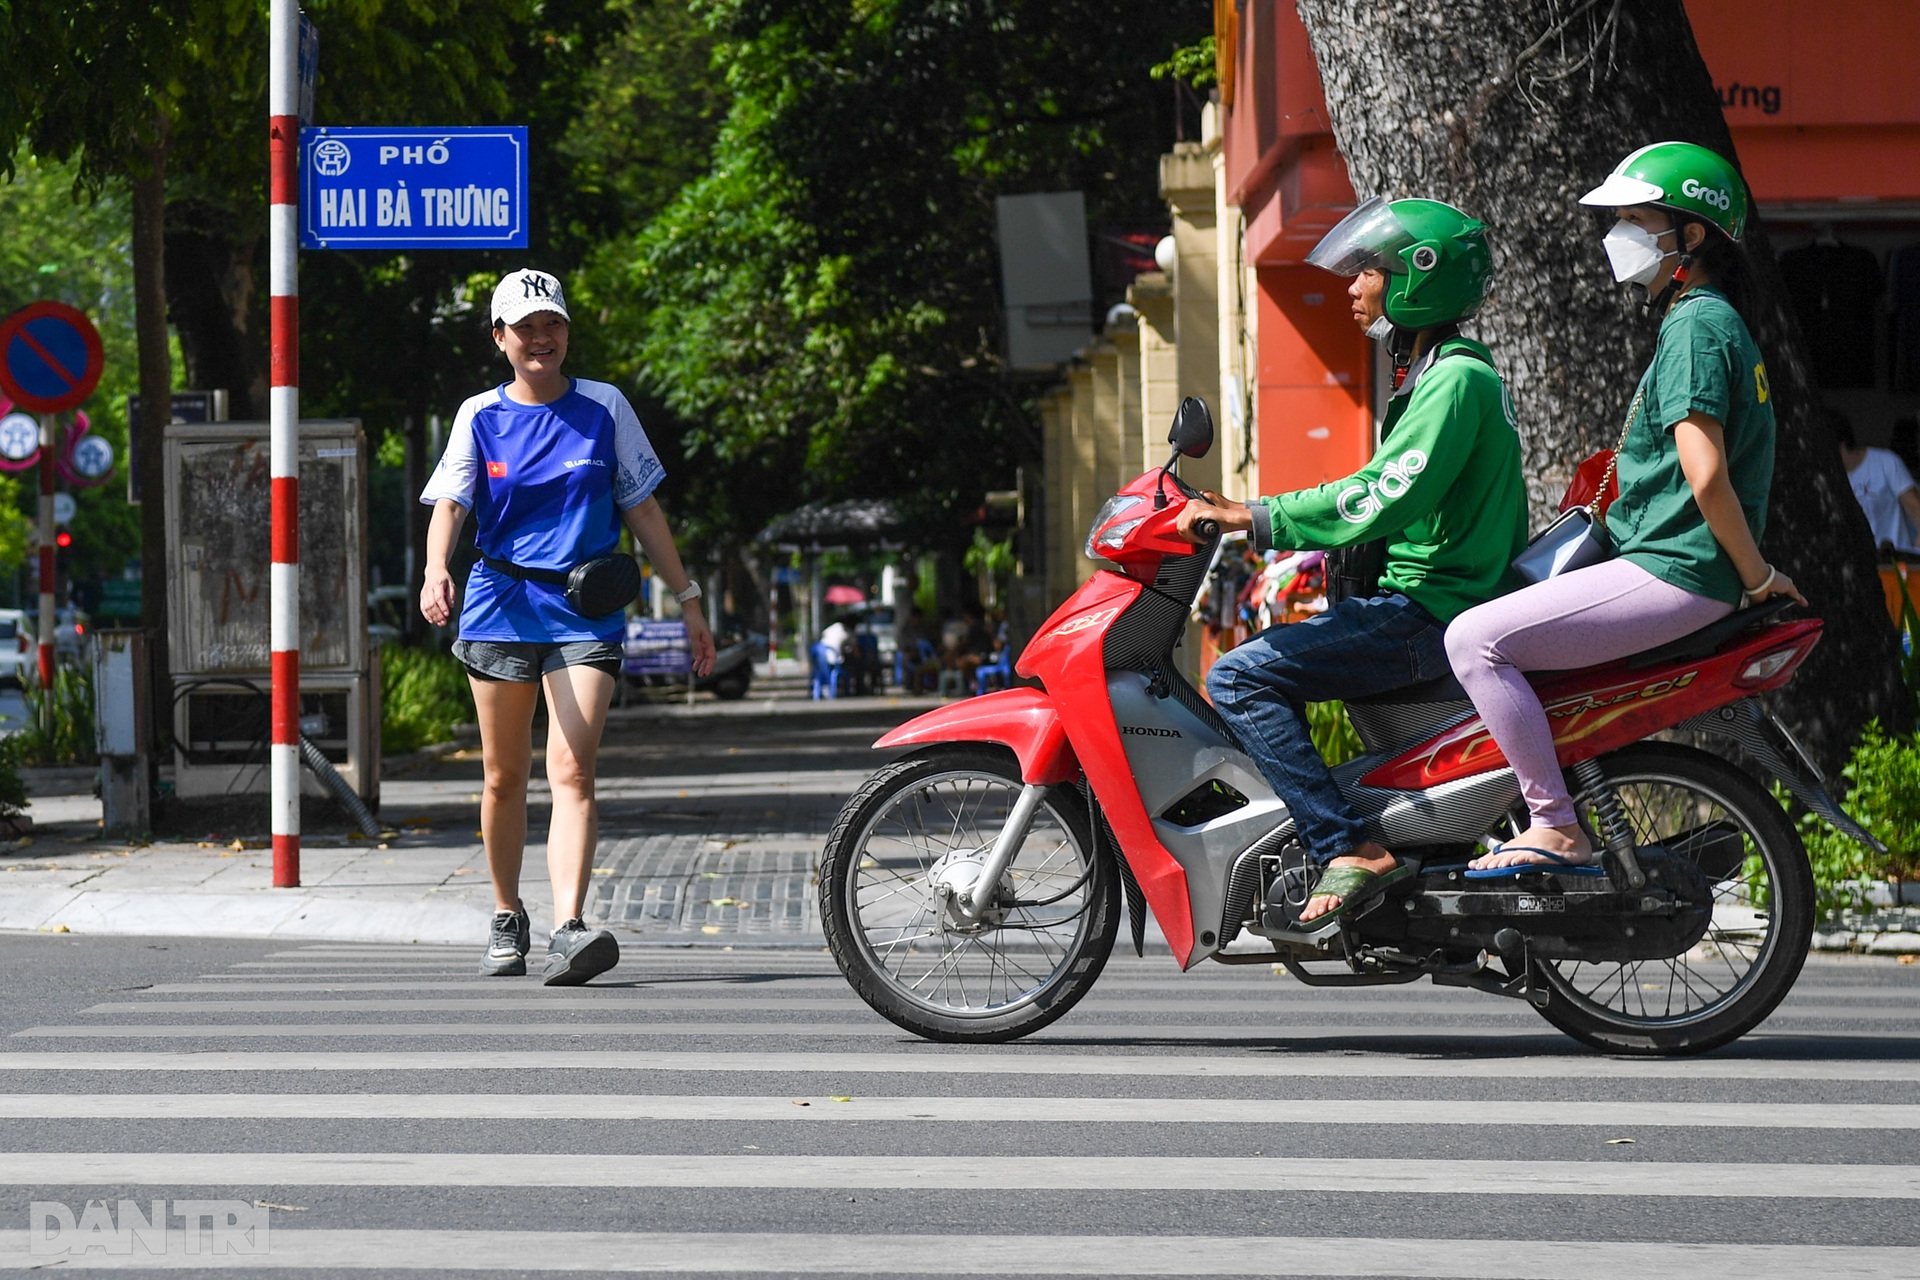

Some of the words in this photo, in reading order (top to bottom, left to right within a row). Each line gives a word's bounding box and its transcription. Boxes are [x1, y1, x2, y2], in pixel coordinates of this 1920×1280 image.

[1716, 81, 1781, 116] ưng
[379, 137, 452, 166] PHỐ
[320, 188, 367, 228] HAI
[376, 180, 413, 228] BÀ
[421, 184, 510, 228] TRƯNG
[1681, 178, 1731, 211] Grab
[1336, 449, 1428, 524] Grab
[1121, 725, 1184, 739] HONDA
